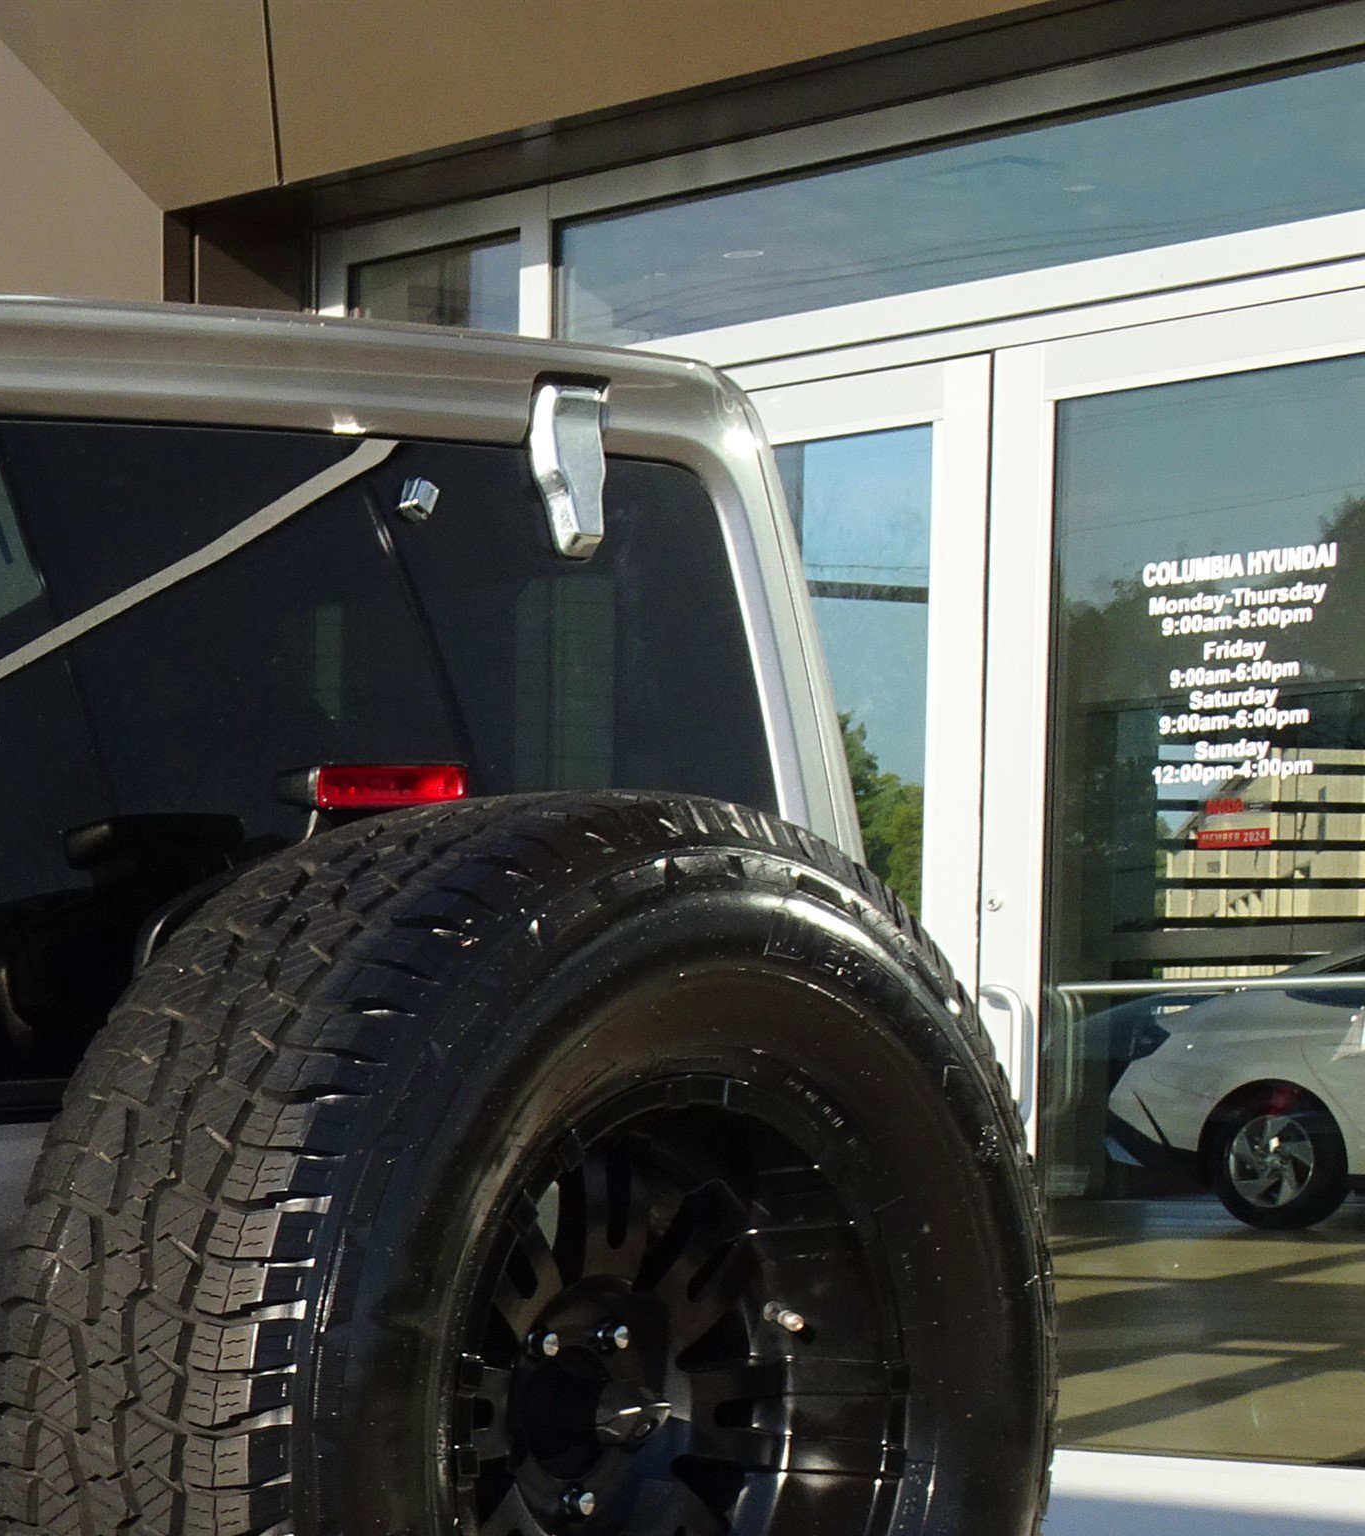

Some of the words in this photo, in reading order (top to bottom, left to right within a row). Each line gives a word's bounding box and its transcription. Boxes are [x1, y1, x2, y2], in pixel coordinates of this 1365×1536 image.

[1142, 553, 1244, 588] COLUMBIA
[1247, 542, 1338, 577] HYUNDAI
[1148, 582, 1327, 617] Monday-Thursday
[1161, 606, 1313, 636] 9:00am-8:00pm
[1203, 640, 1267, 661] Friday
[1169, 660, 1301, 689] 9:00am-6:00pm
[1188, 686, 1279, 711] Saturday
[1158, 707, 1310, 735] 9:00am-6:00pm
[1194, 738, 1271, 761] Sunday
[1151, 758, 1314, 785] 12:00pm-4:00pm
